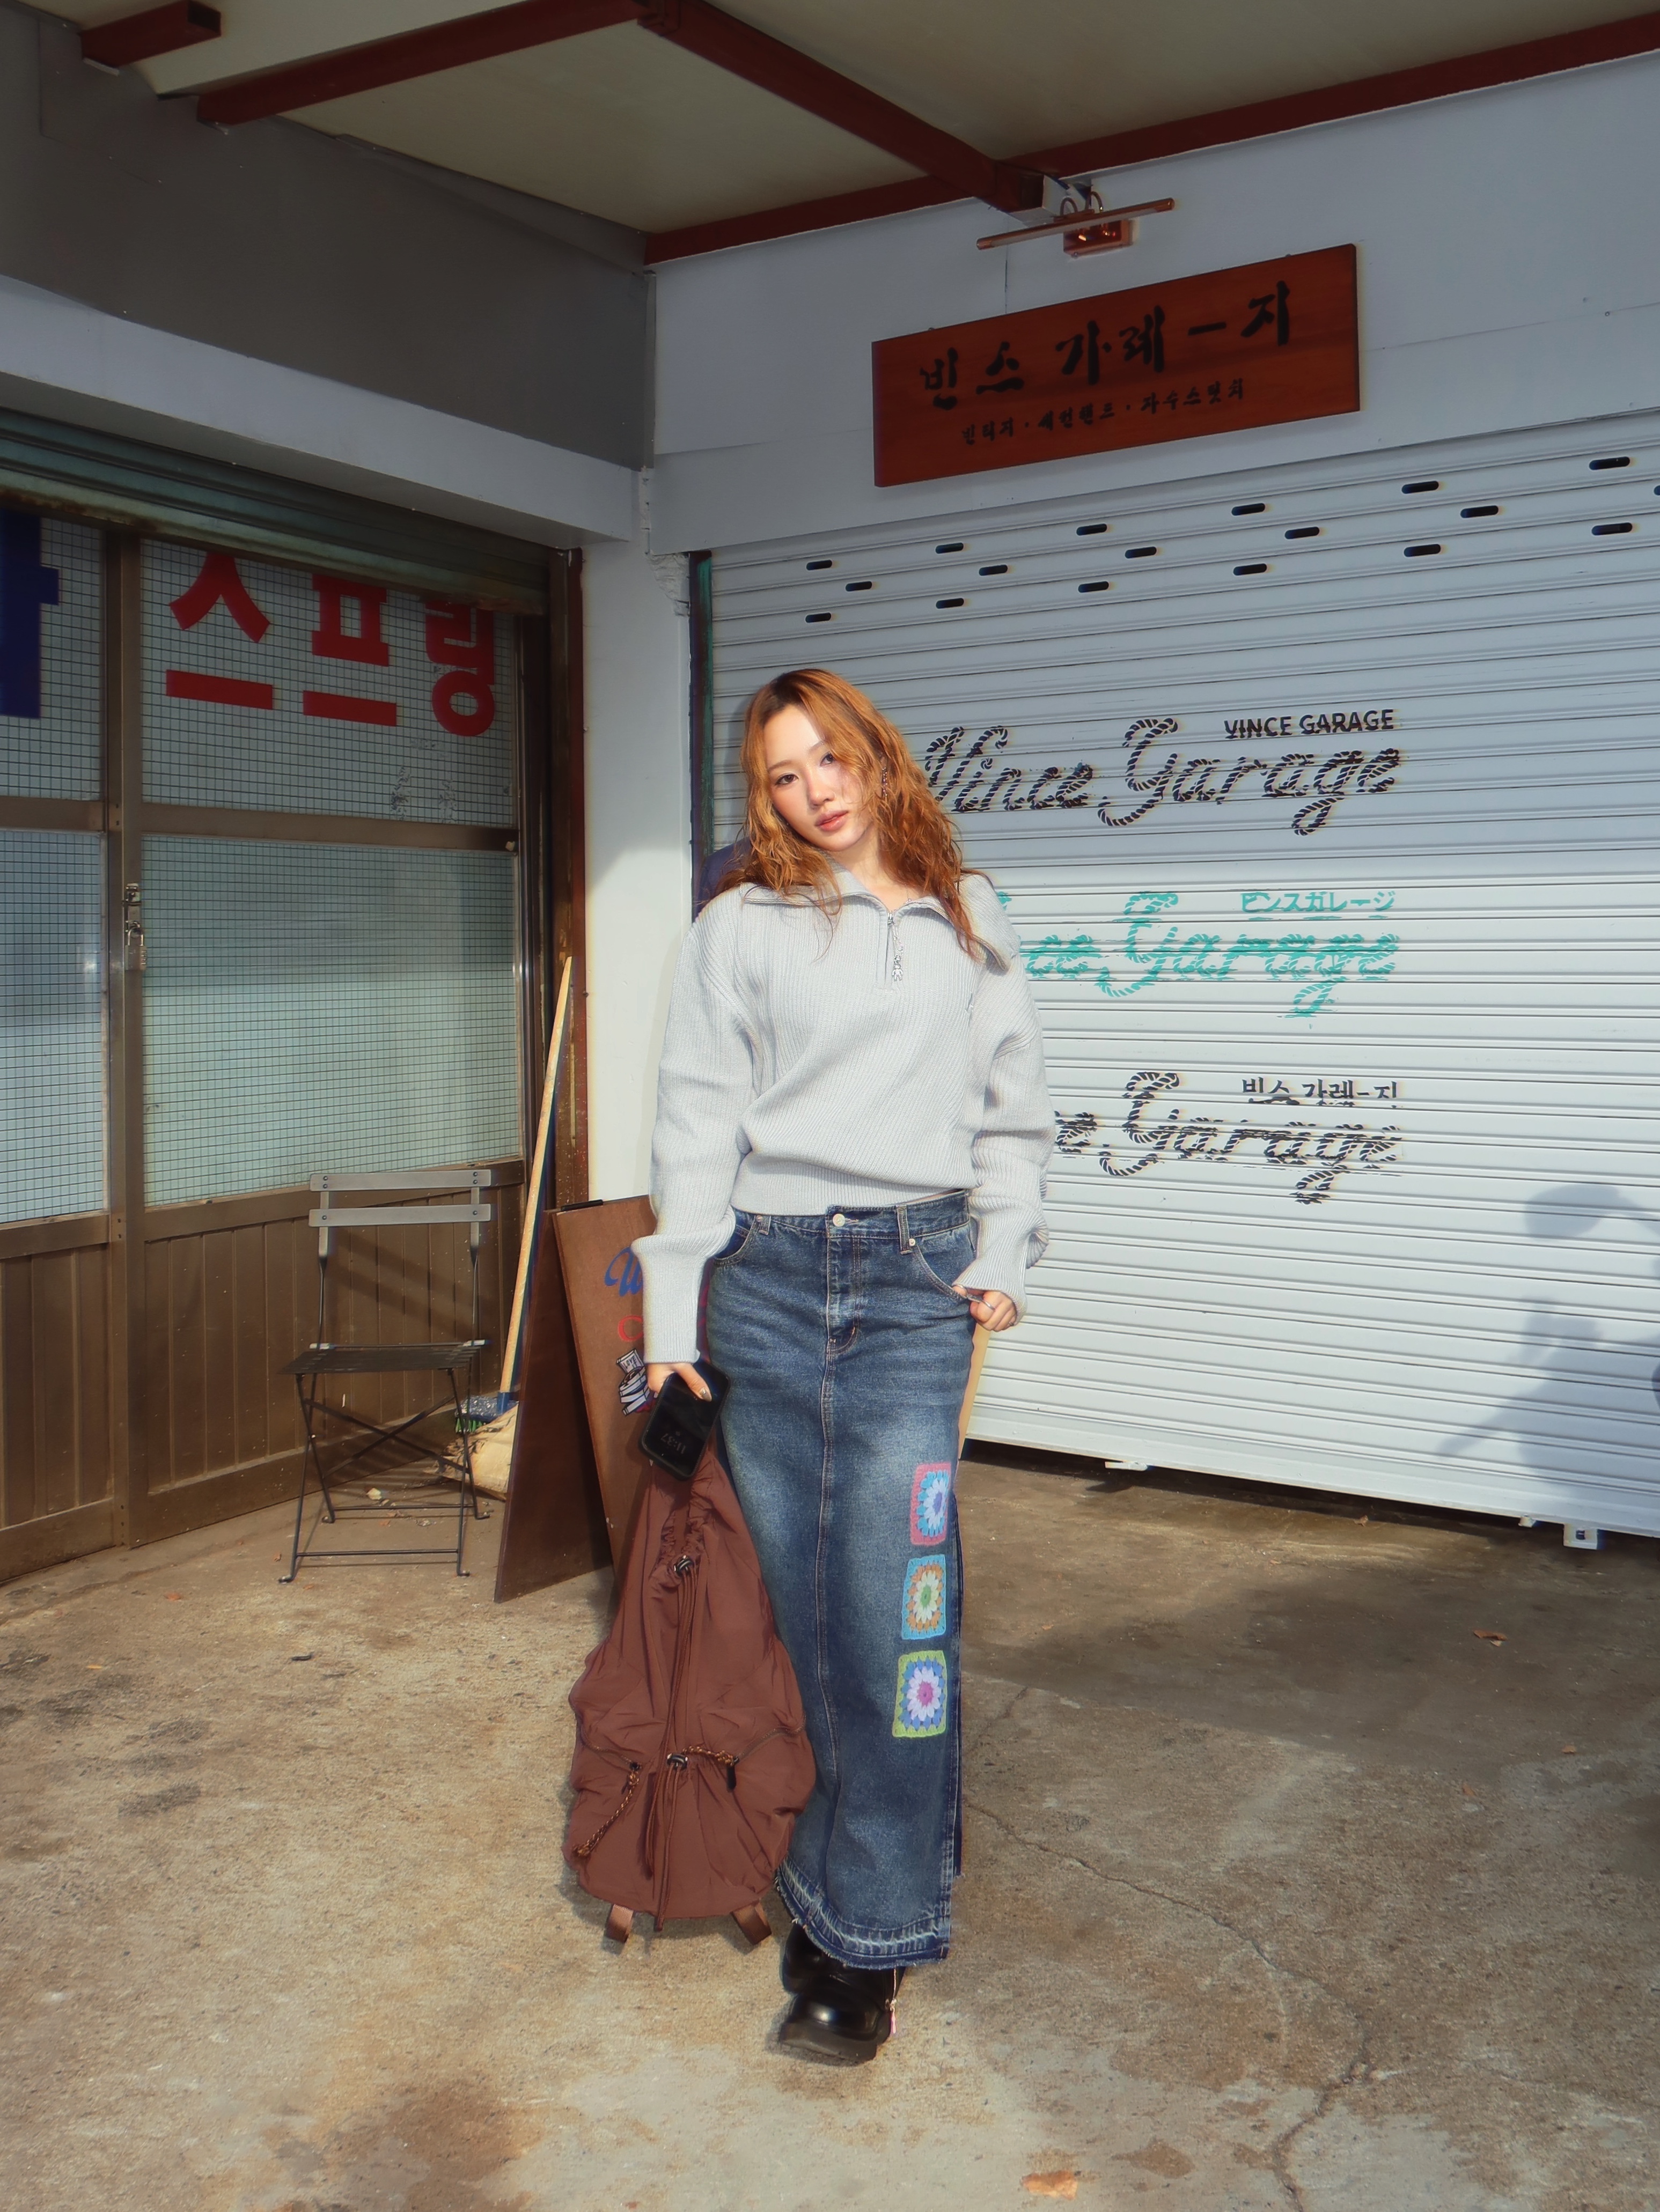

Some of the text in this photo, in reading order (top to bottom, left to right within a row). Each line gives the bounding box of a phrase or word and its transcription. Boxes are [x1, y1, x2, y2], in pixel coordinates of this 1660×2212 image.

[919, 341, 1025, 410] 빈스
[961, 416, 1014, 446] 빈티지
[166, 552, 496, 737] 스프링
[1224, 709, 1394, 739] VINCE GARAGE
[924, 718, 1400, 836] Vince Garage
[1095, 891, 1400, 1018] Garage
[1098, 1072, 1402, 1205] Garage
[622, 1355, 637, 1369] LOVE
[660, 1433, 687, 1455] 11:37
